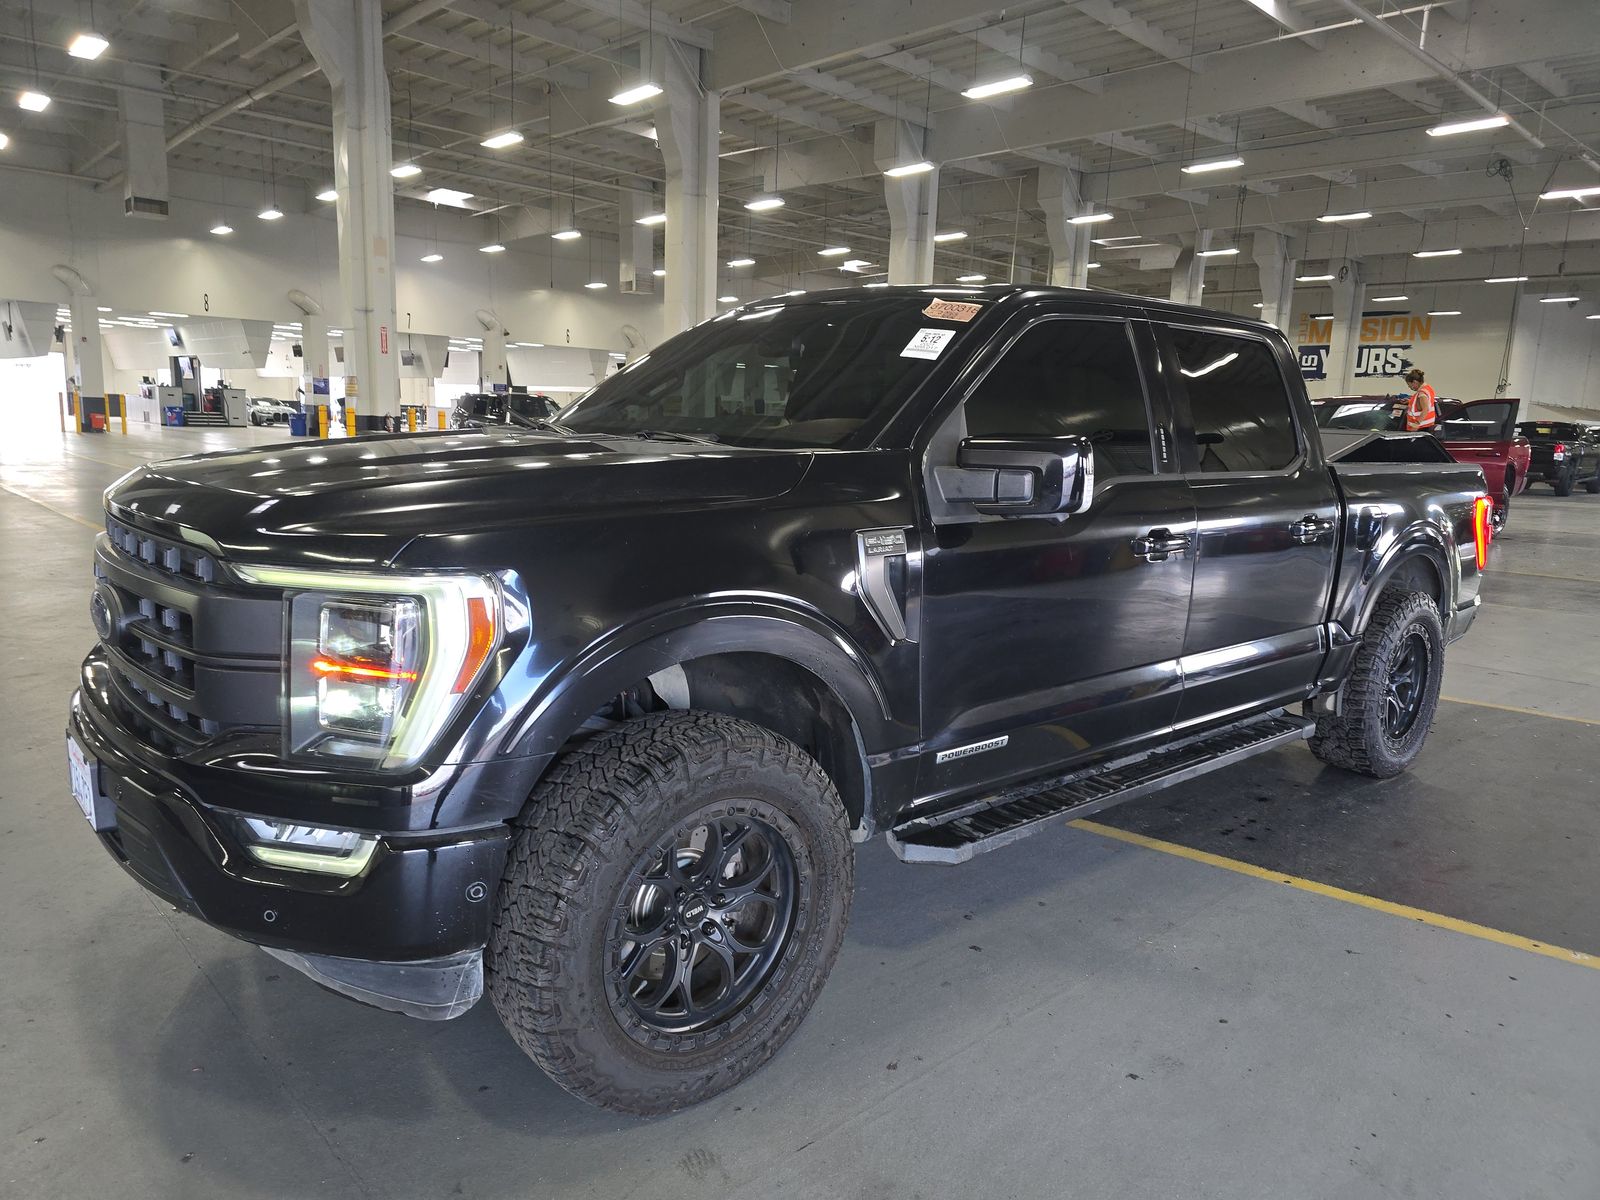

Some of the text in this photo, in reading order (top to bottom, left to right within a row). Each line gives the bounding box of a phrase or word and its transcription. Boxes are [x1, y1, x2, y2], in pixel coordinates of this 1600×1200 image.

[203, 293, 210, 312] 8
[920, 335, 942, 344] 5:12
[1308, 317, 1432, 343] MSION
[1319, 348, 1403, 373] YURS
[941, 738, 1006, 761] POWERBOOST
[685, 905, 704, 918] WELD
